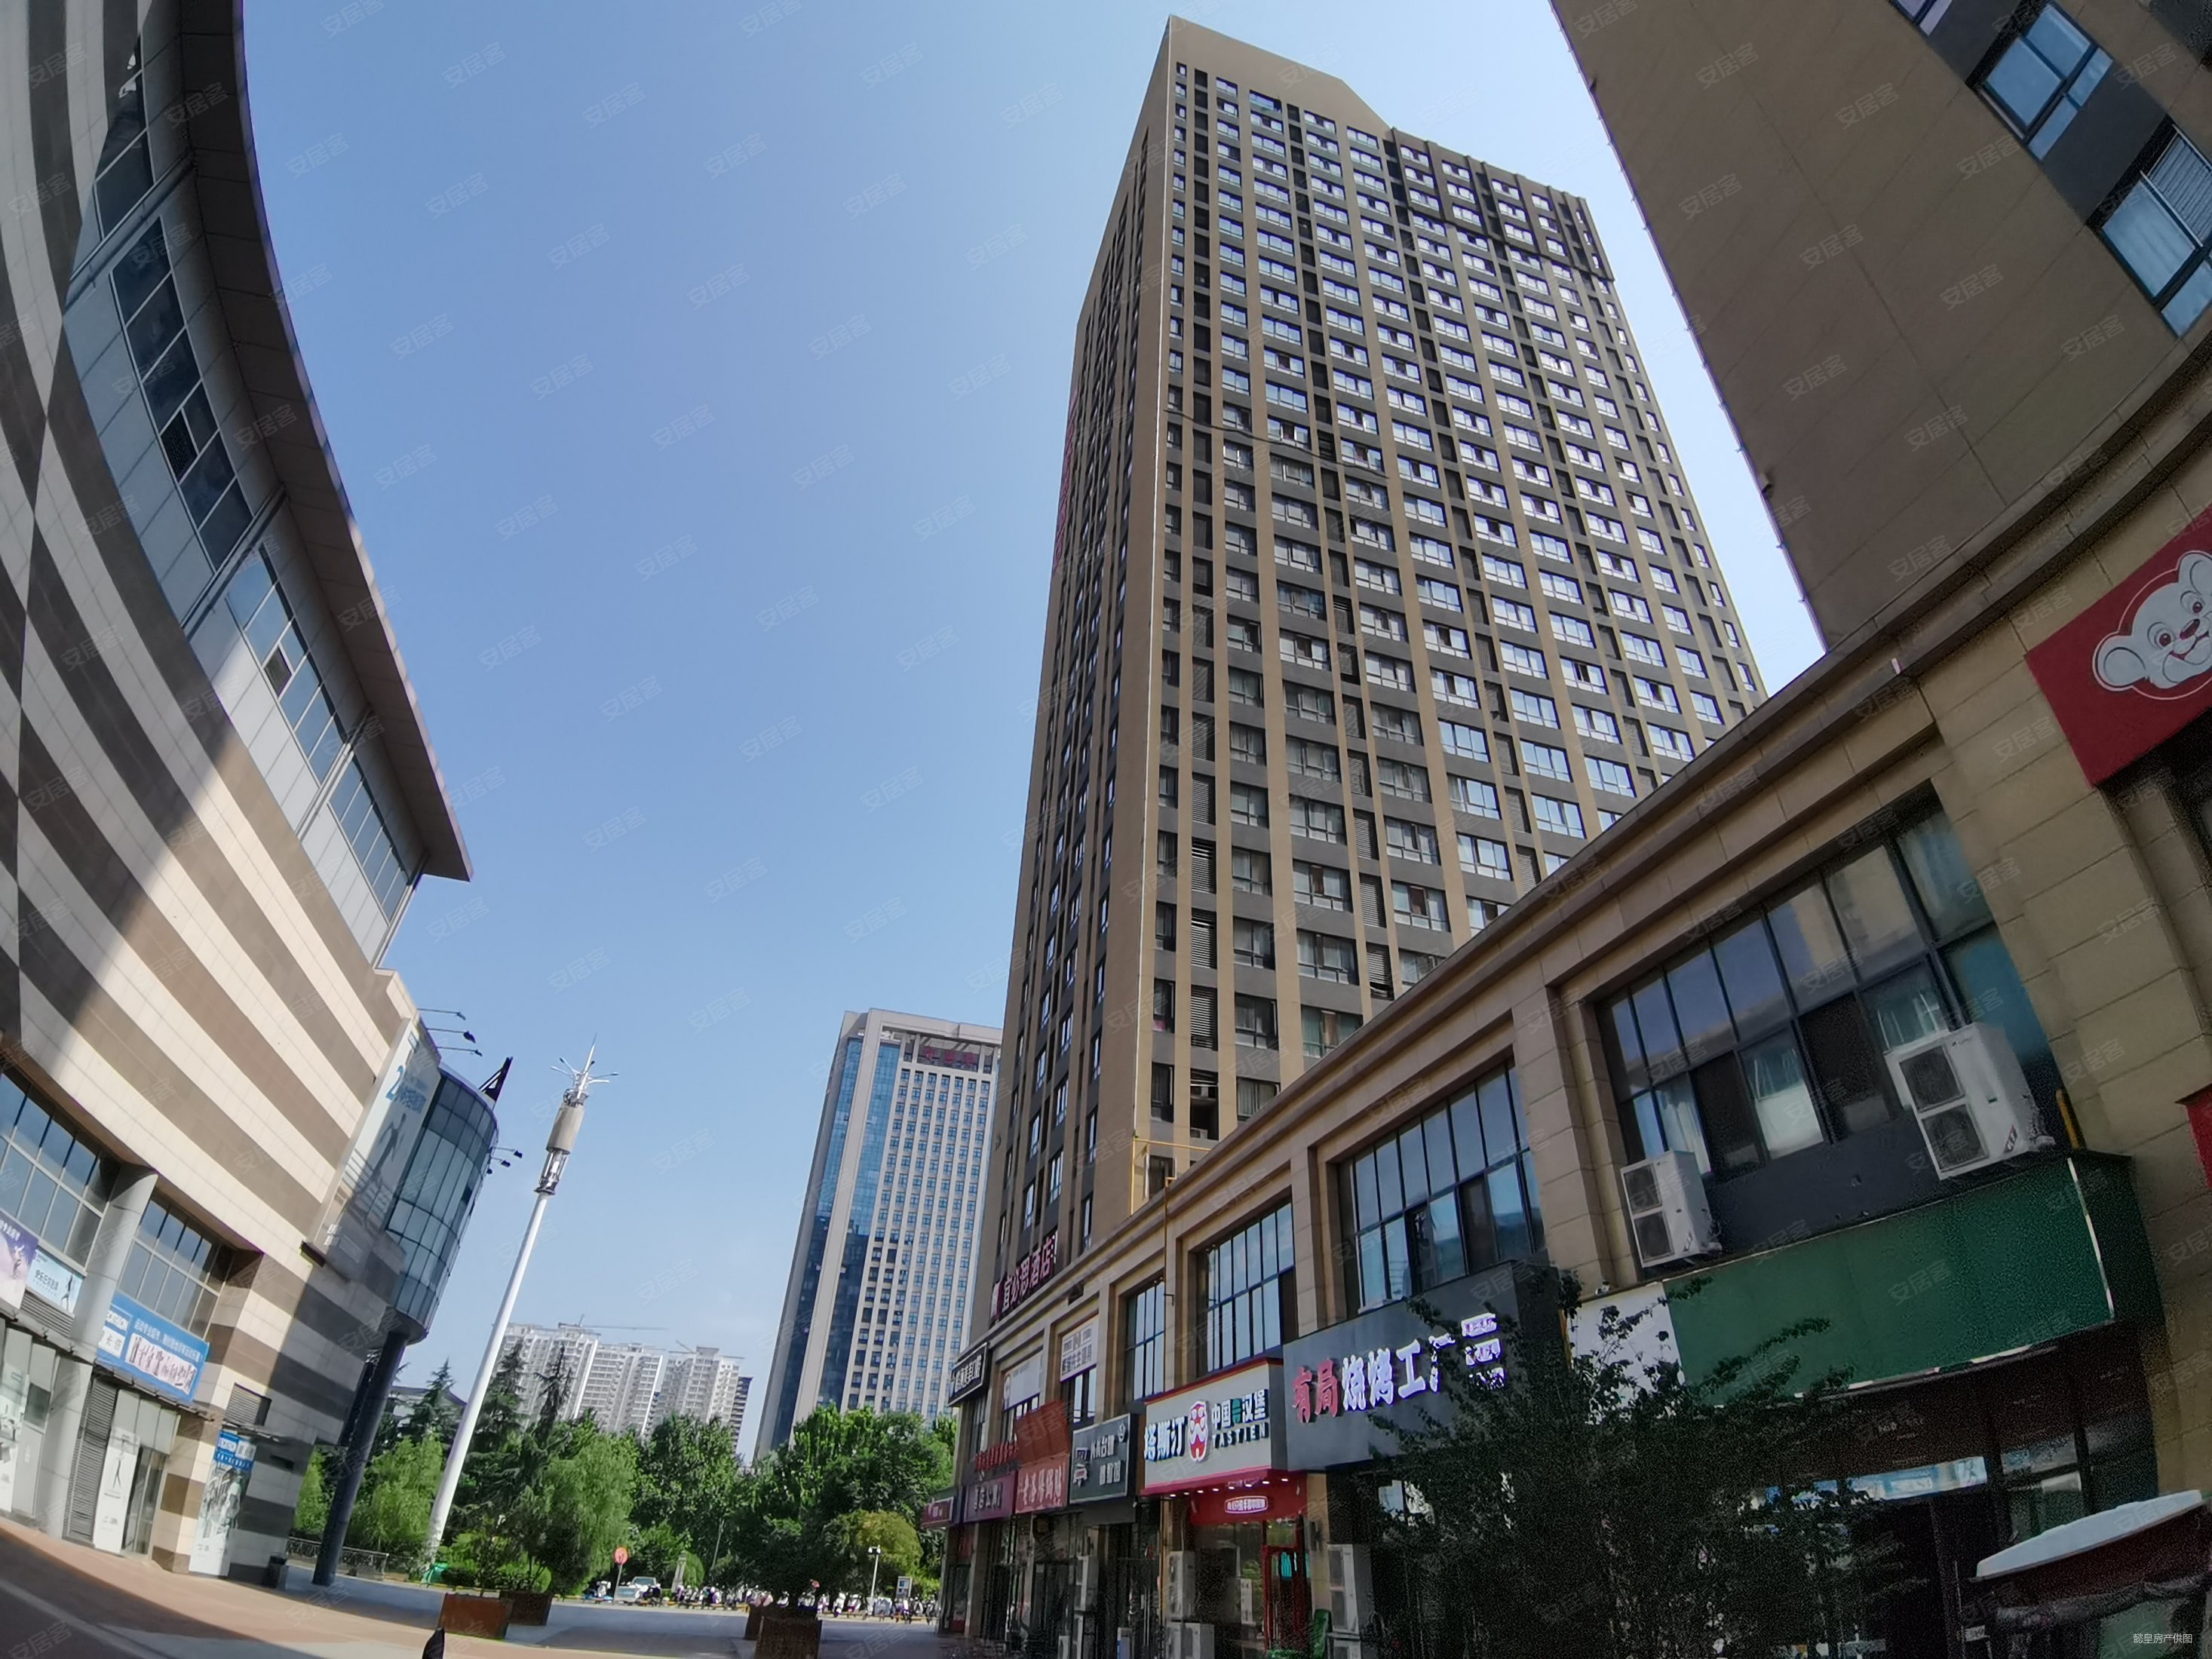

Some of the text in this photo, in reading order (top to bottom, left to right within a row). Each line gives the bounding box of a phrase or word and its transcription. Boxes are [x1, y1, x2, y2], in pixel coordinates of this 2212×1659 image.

[1002, 1236, 1054, 1313] 宜必思酒店
[1212, 1422, 1268, 1448] TASTIEN
